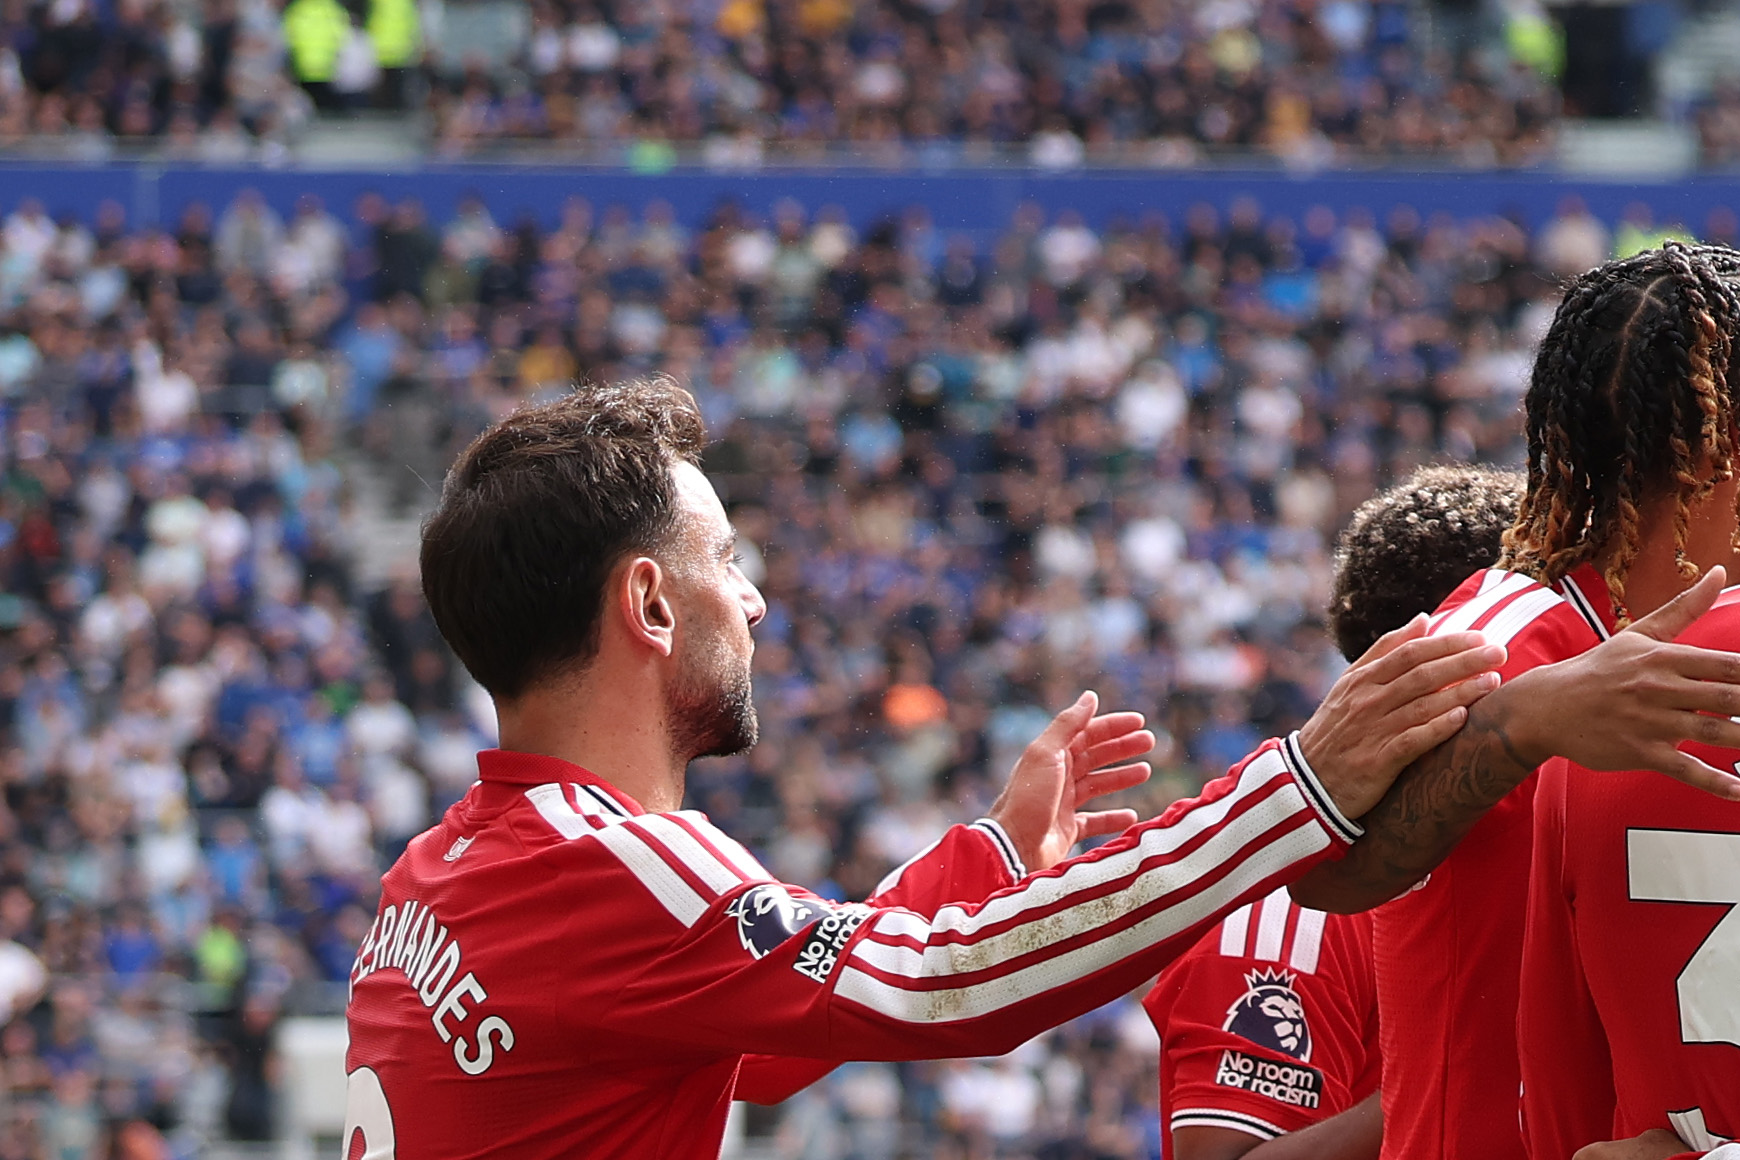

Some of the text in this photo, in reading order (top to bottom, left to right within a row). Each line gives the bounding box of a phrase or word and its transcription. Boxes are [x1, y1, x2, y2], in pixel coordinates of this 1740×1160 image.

[793, 906, 851, 977] No roo
[809, 949, 838, 984] for
[1216, 1066, 1319, 1109] for racism
[1219, 1049, 1314, 1089] No room
